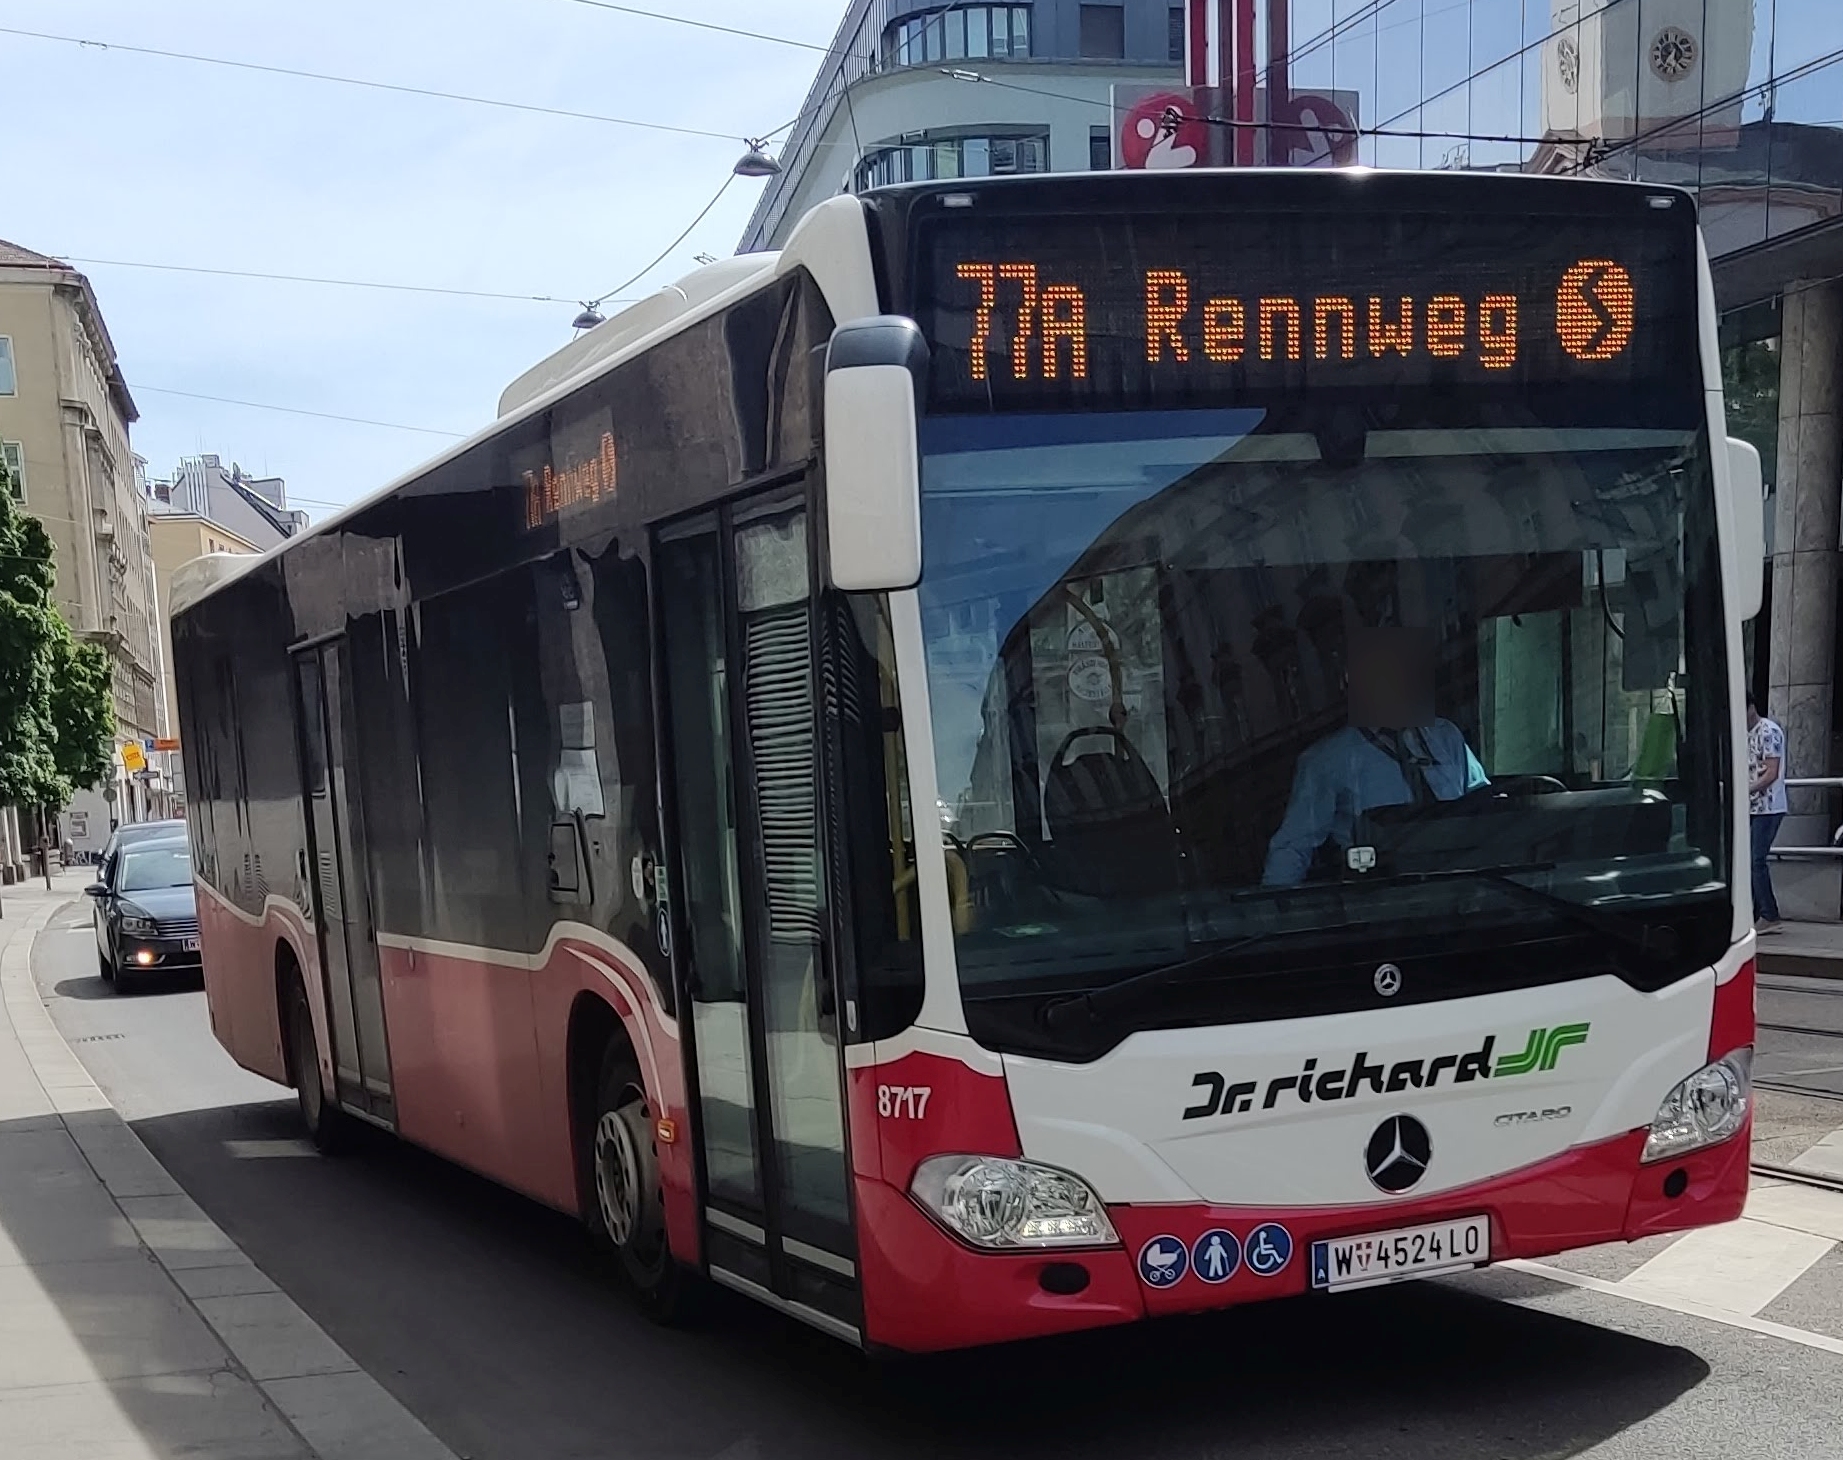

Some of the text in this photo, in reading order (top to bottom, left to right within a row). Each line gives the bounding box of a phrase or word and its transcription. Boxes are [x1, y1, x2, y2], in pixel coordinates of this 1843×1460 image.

[955, 262, 1087, 380] 77A
[1145, 267, 1518, 369] Rennweg
[877, 1084, 932, 1120] 8717
[1182, 1034, 1496, 1121] Dr. richard
[1493, 1105, 1572, 1128] CITARO
